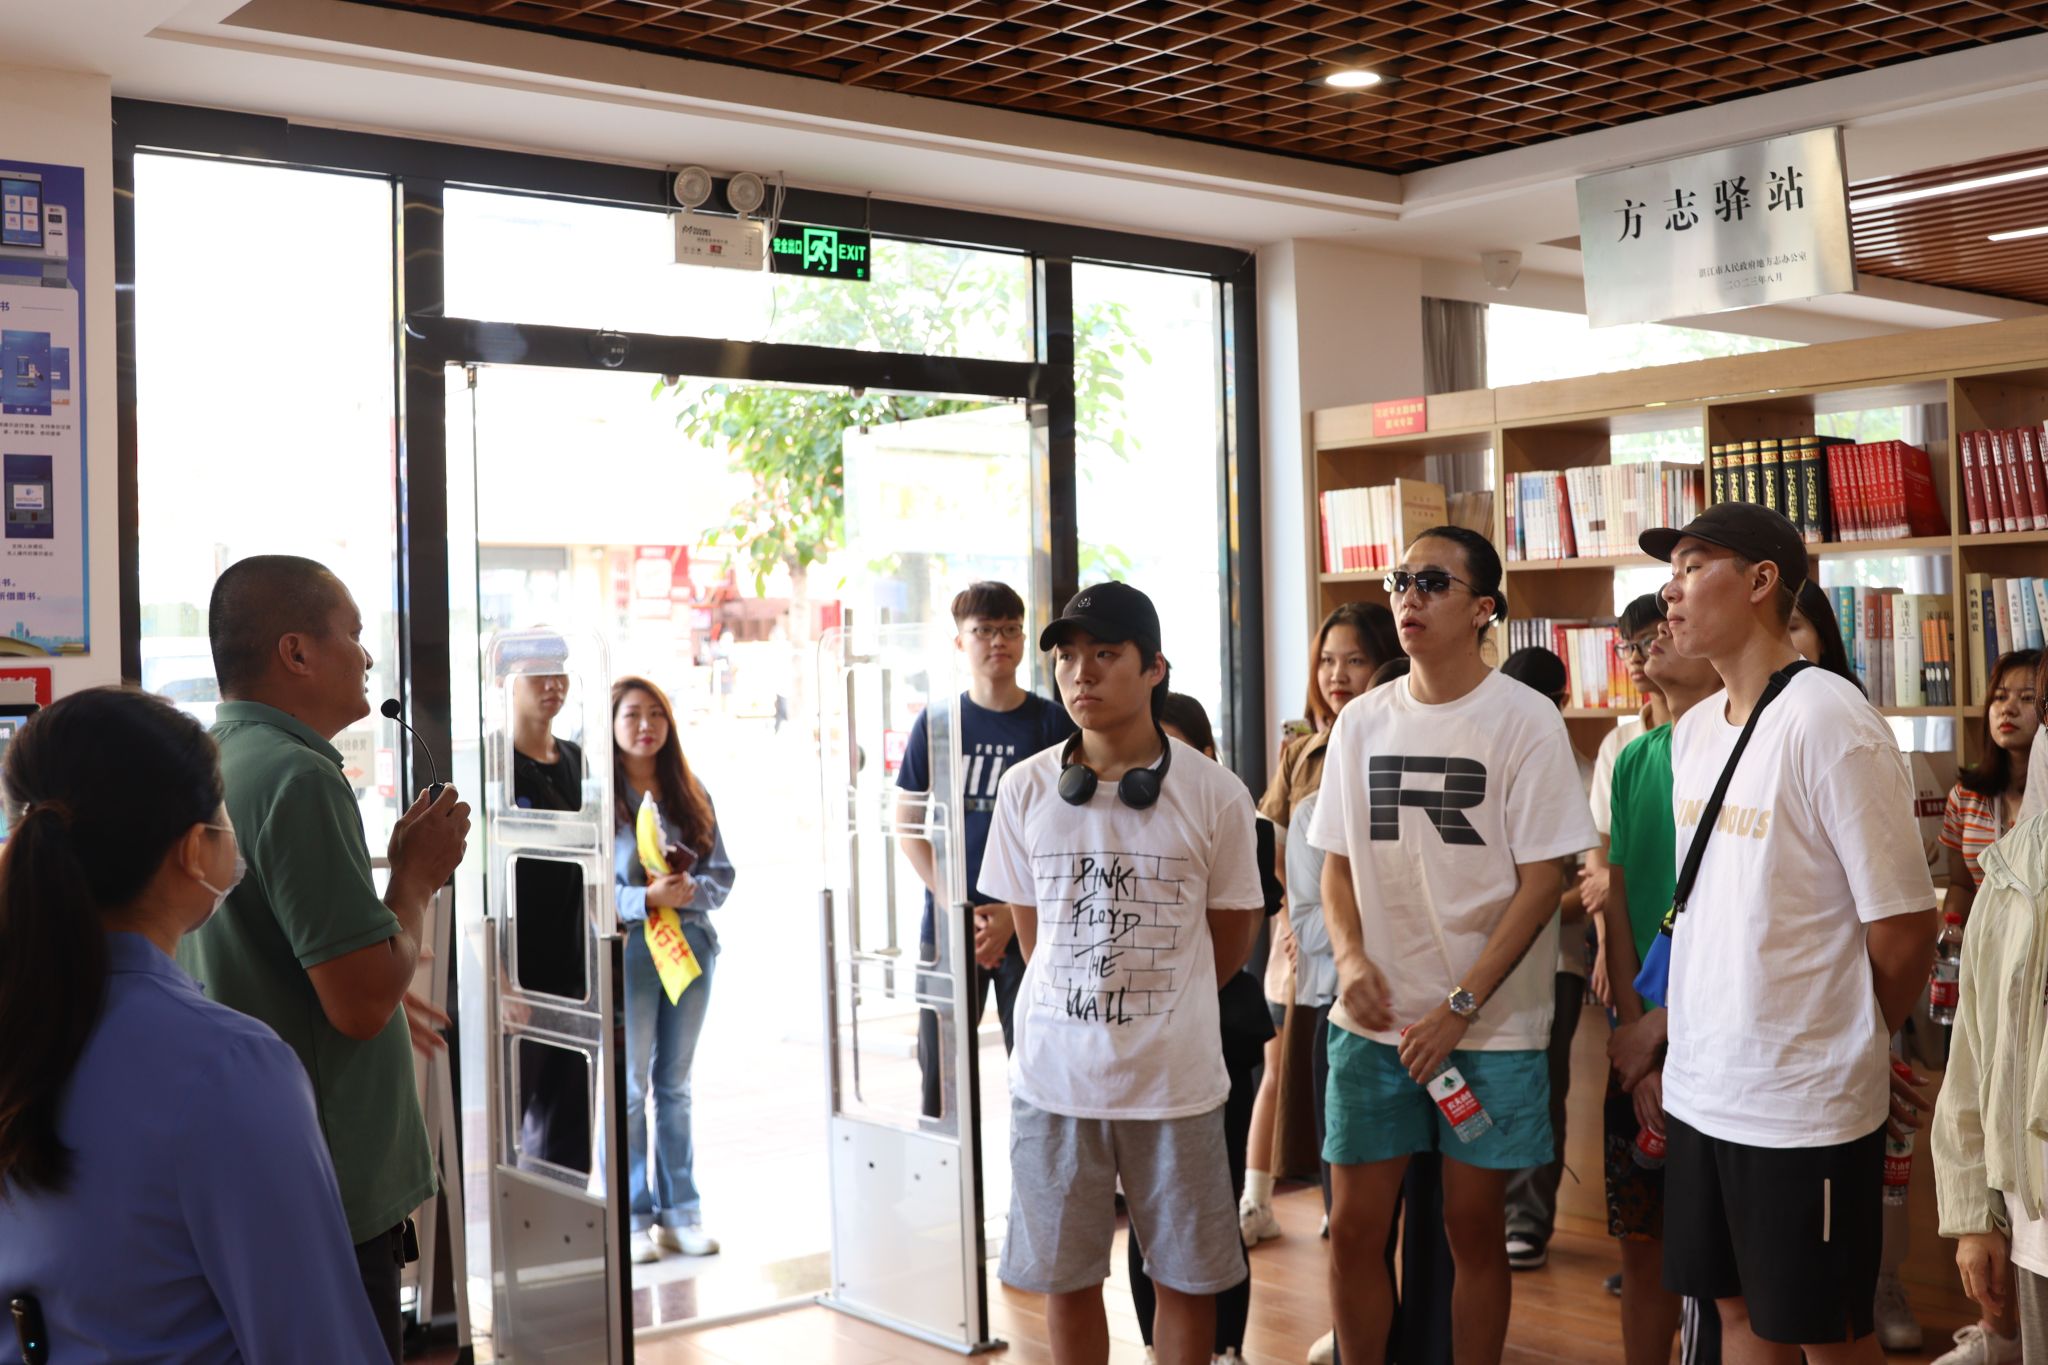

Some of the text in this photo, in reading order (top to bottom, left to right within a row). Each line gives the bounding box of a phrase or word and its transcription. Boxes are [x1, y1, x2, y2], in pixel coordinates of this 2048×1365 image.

[1613, 166, 1805, 243] 方志驿站
[773, 237, 803, 255] 安全出口
[838, 244, 866, 262] EXIT
[1698, 251, 1807, 279] 湛江市人民政府地方志办公室
[975, 743, 1015, 756] FROM
[1369, 755, 1487, 846] R
[1074, 857, 1134, 902] PINK
[1072, 890, 1141, 943] FLOYD
[1075, 939, 1125, 979] THE
[1066, 978, 1132, 1025] WALL
